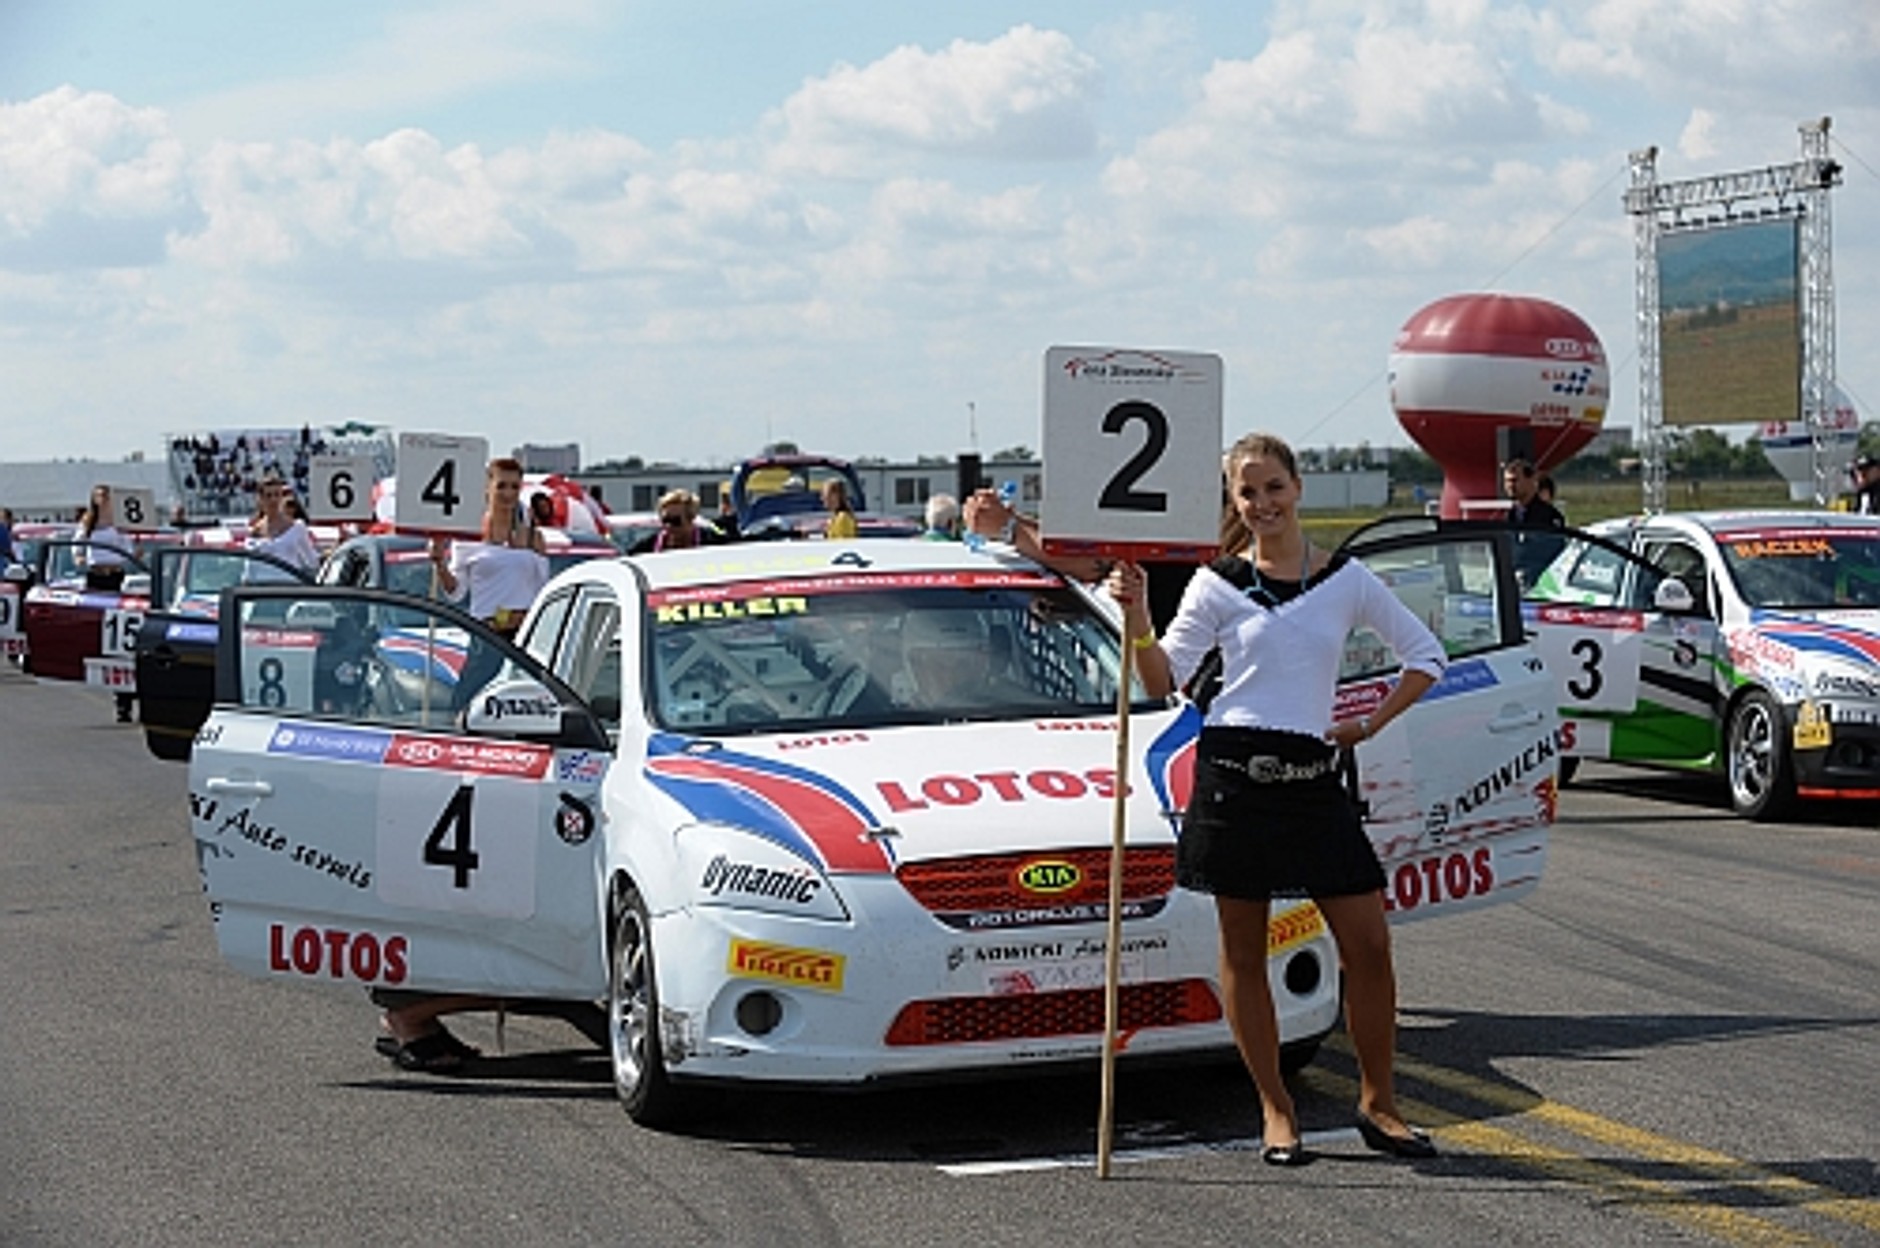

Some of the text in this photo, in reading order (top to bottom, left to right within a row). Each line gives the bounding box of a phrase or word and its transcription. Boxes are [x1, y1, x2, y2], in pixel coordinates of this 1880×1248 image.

[1098, 400, 1169, 512] 2
[123, 496, 144, 524] 8
[329, 471, 355, 509] 6
[421, 459, 460, 516] 4
[105, 613, 141, 652] 15
[657, 597, 808, 623] KILLER
[259, 657, 286, 708] 8
[1568, 638, 1602, 700] 3
[776, 733, 870, 751] LOTOS
[876, 769, 1133, 814] LOTOS
[216, 808, 288, 851] Auto
[290, 845, 372, 890] serwis
[423, 785, 479, 888] 4
[1029, 867, 1073, 886] KIA
[1384, 847, 1494, 912] OTOS
[269, 923, 408, 984] LOTOS
[736, 943, 835, 983] PIRELLI
